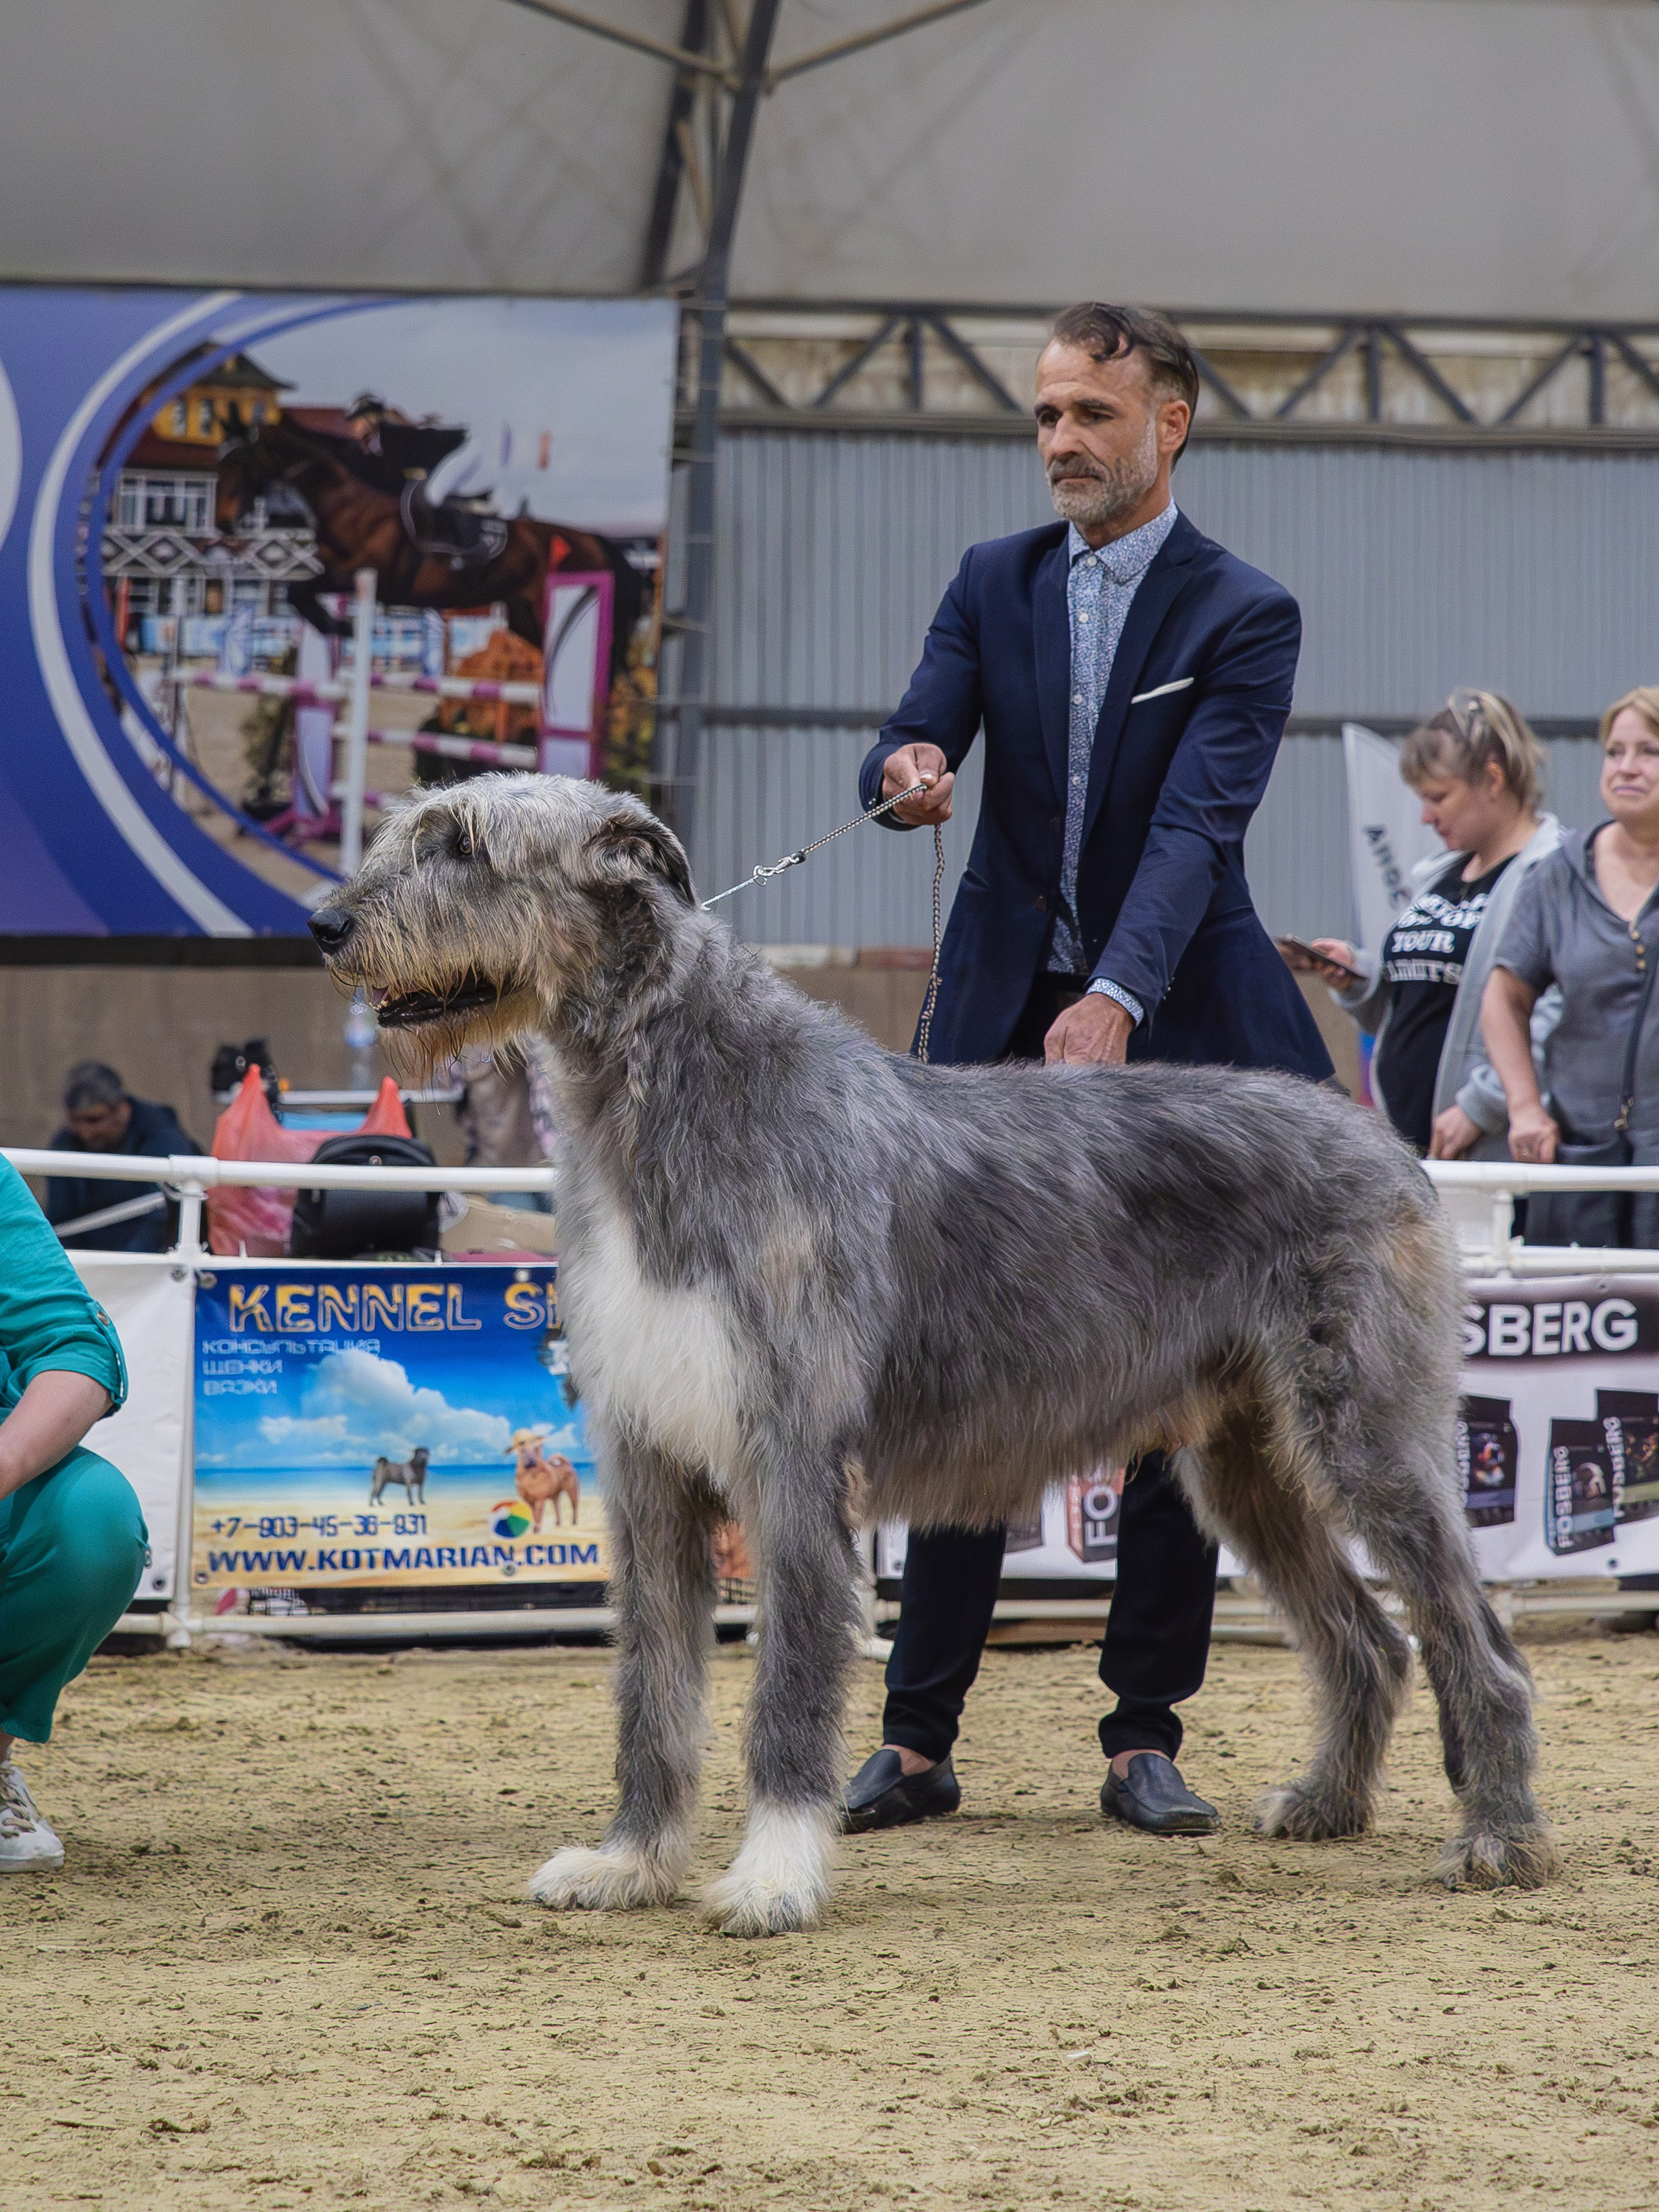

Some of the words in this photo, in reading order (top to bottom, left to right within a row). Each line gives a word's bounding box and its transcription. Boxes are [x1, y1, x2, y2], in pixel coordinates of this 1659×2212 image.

[1391, 929, 1456, 953] YOUR
[229, 1283, 483, 1333] KENNEL
[1084, 1471, 1119, 1547] FO
[209, 1544, 599, 1572] WWW.KOTMARIAN.COM
